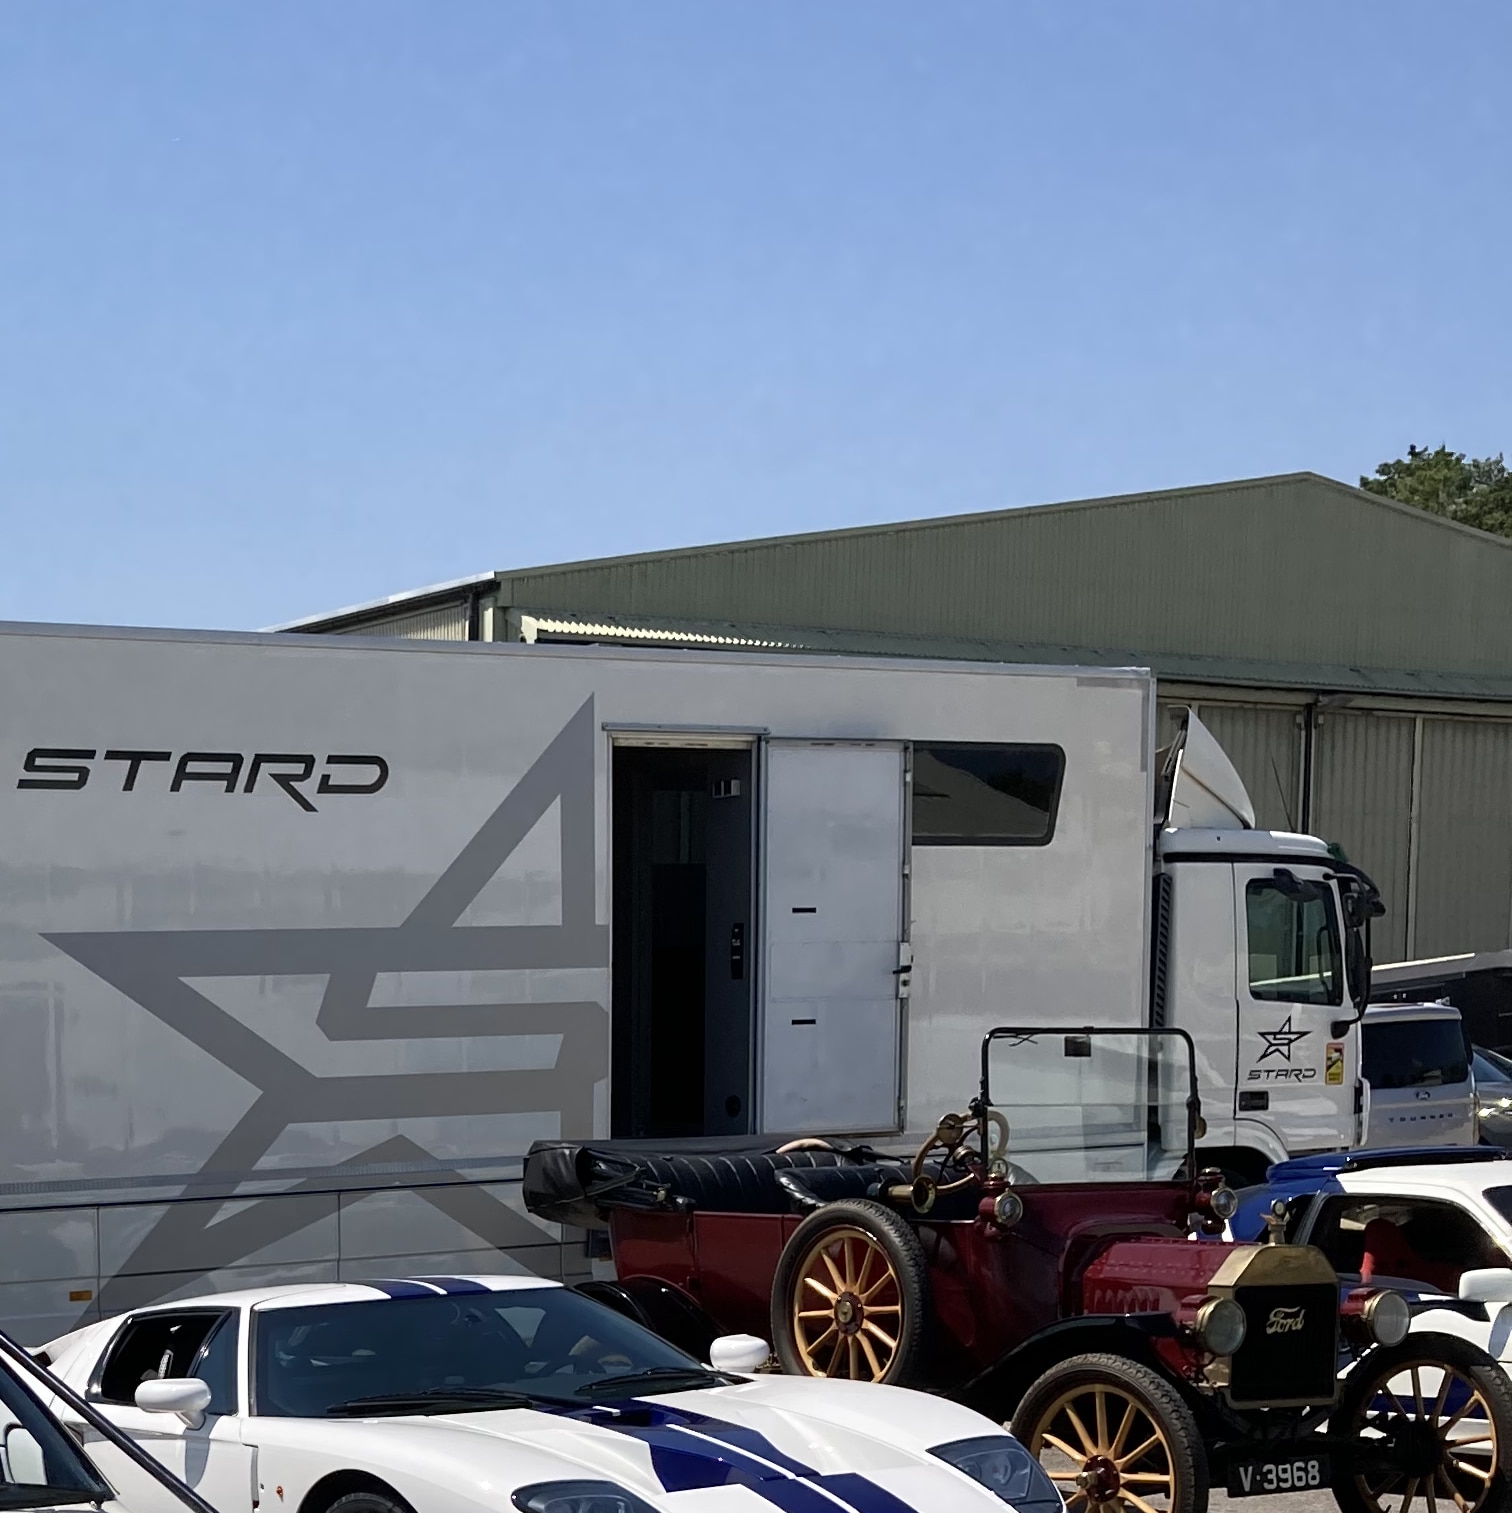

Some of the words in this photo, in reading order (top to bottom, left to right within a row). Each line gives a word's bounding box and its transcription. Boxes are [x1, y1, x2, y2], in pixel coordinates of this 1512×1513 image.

[16, 748, 390, 812] STARD
[1247, 1068, 1317, 1083] STARD
[1265, 1306, 1306, 1335] Ford
